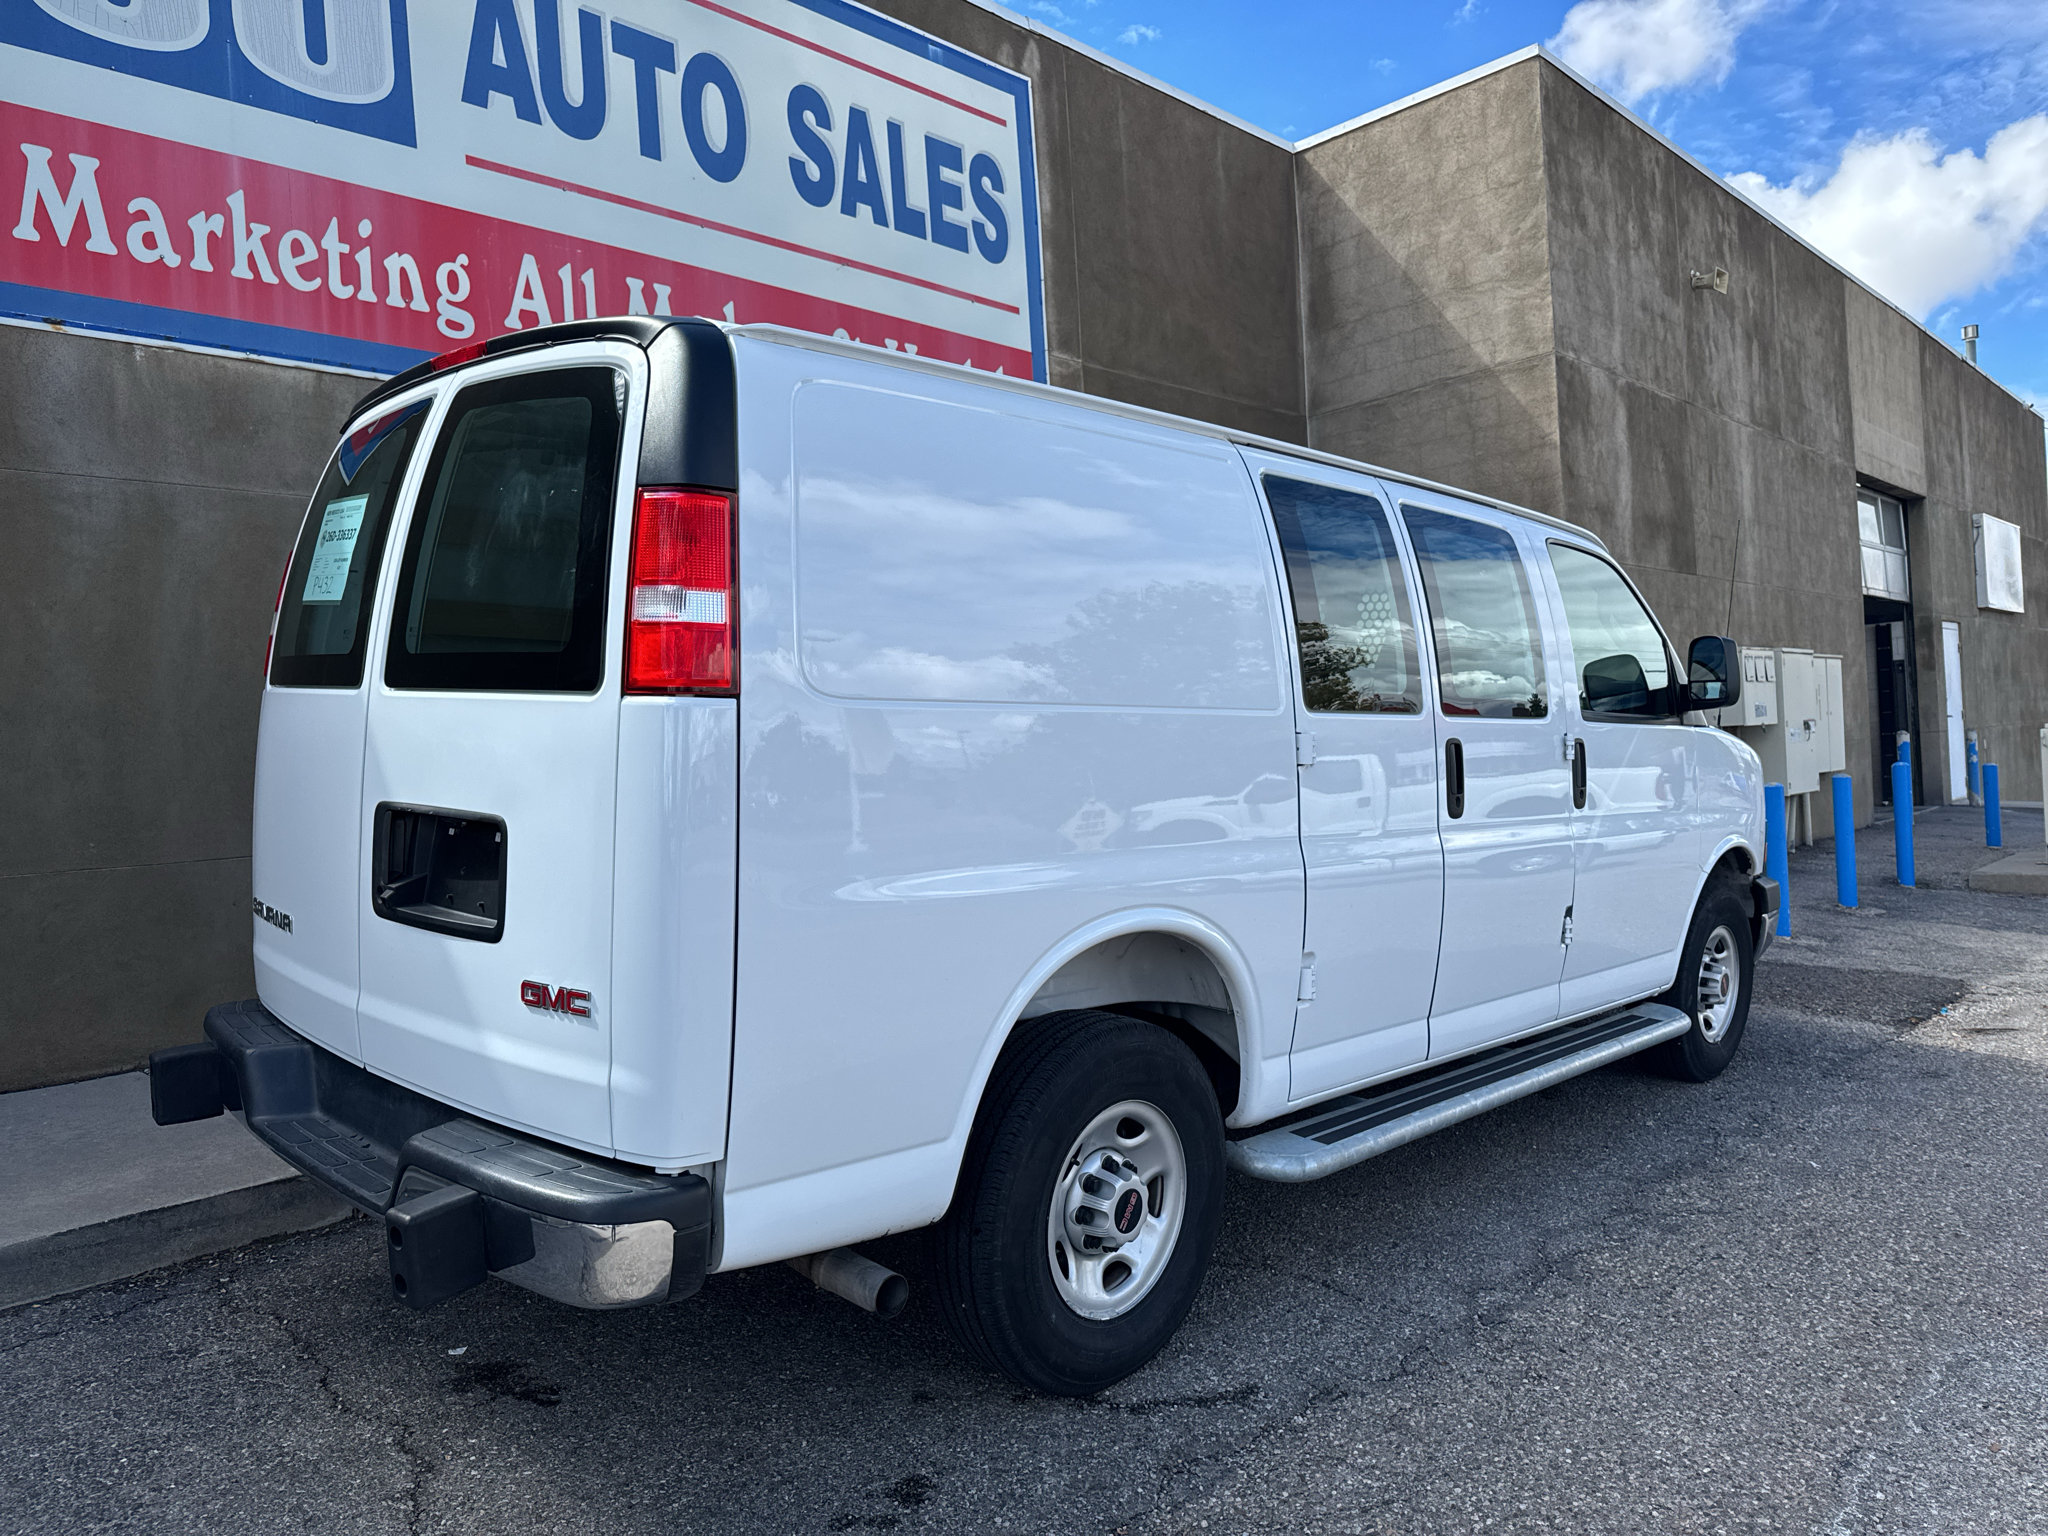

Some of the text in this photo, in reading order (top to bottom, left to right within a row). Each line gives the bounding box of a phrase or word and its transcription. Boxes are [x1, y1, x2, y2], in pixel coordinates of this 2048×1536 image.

[461, 0, 747, 184] AUTO
[787, 82, 1009, 264] SALES
[12, 142, 597, 339] Marketing All
[520, 979, 592, 1018] GMC
[1119, 1192, 1138, 1232] GMC
